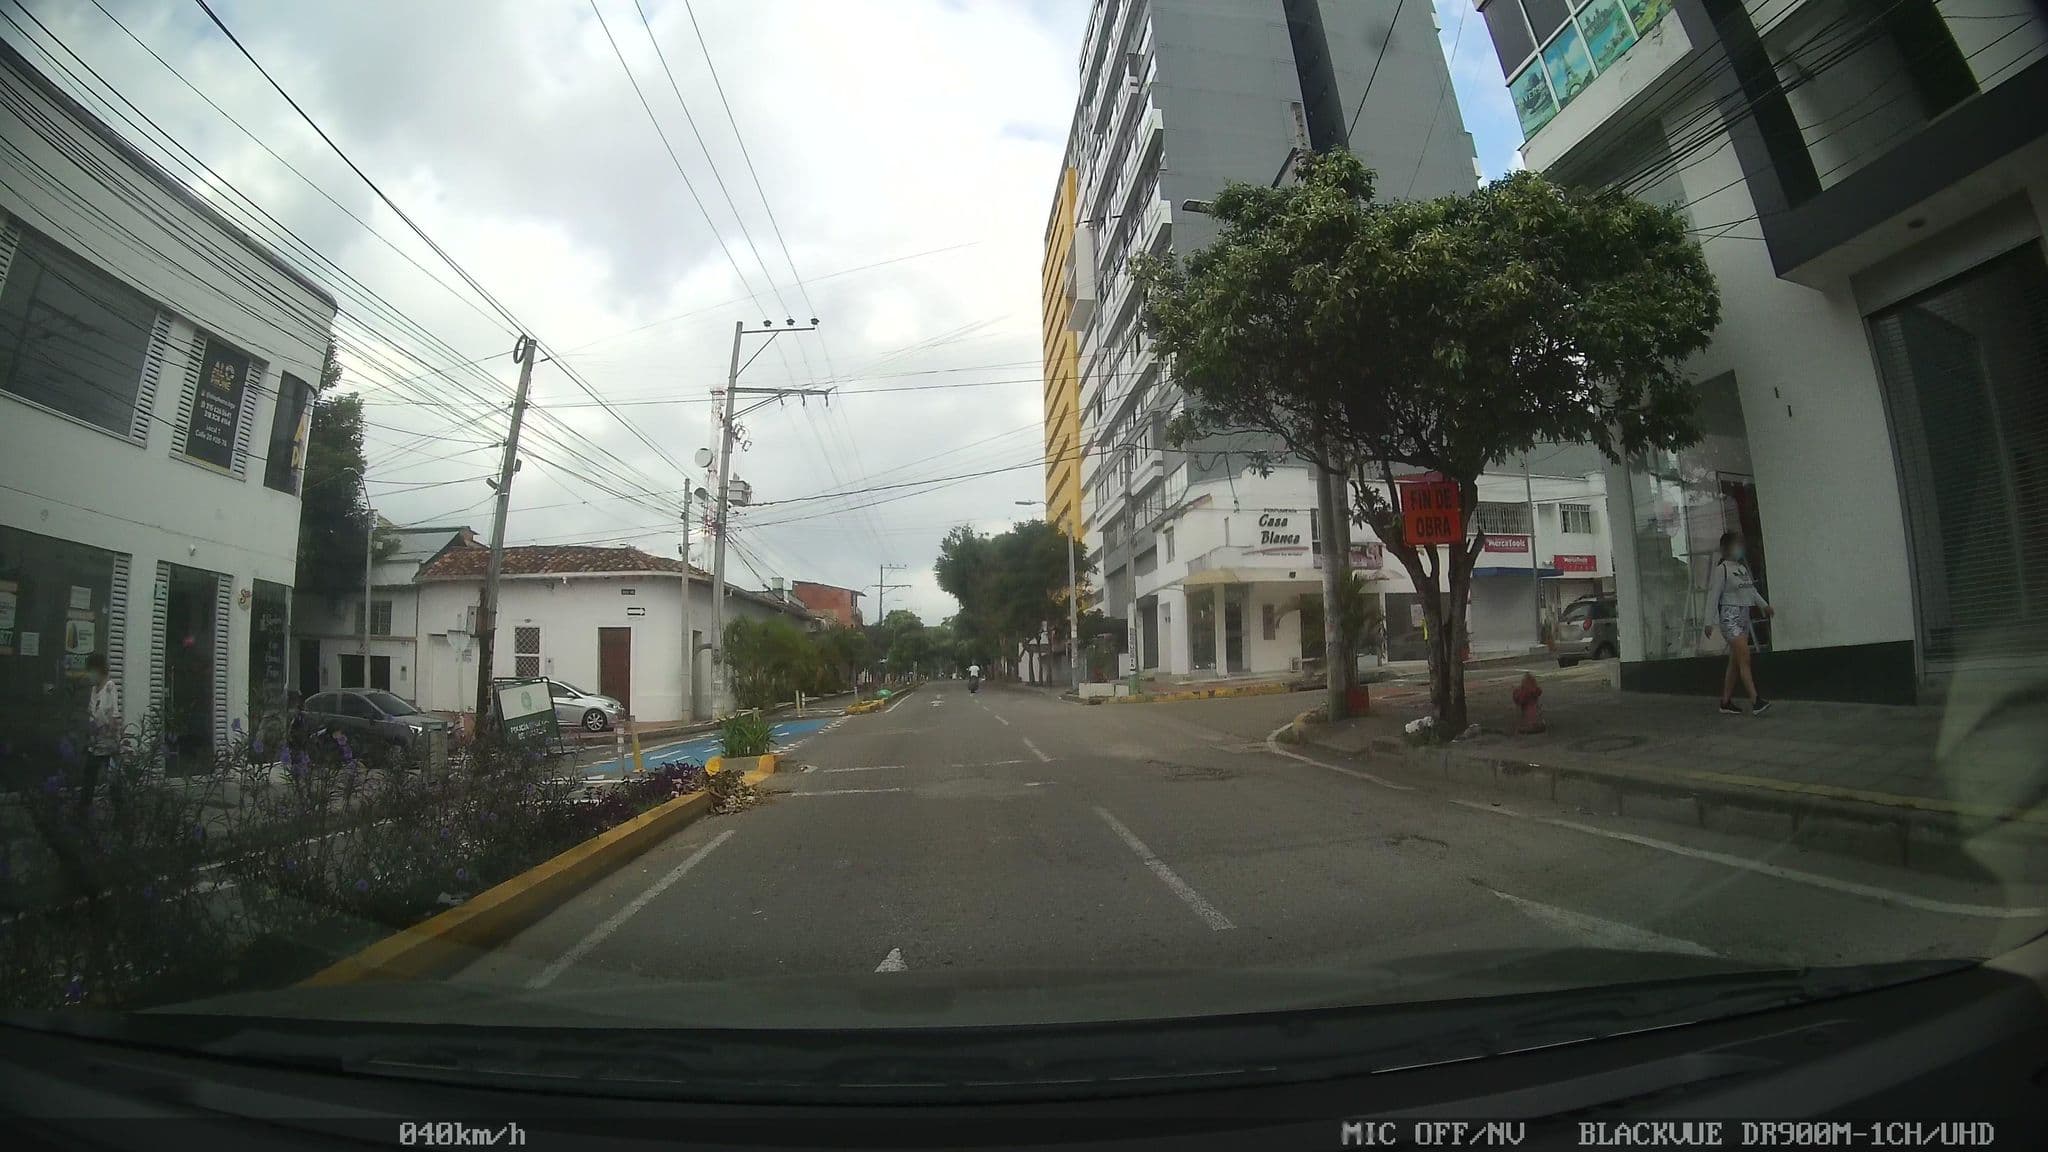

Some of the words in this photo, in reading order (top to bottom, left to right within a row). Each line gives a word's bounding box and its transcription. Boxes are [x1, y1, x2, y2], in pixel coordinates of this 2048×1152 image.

[1410, 489, 1431, 510] FIN
[1436, 488, 1452, 509] DE
[1259, 514, 1288, 527] Casa
[1416, 517, 1452, 537] OBRA
[1261, 530, 1300, 545] Blanca
